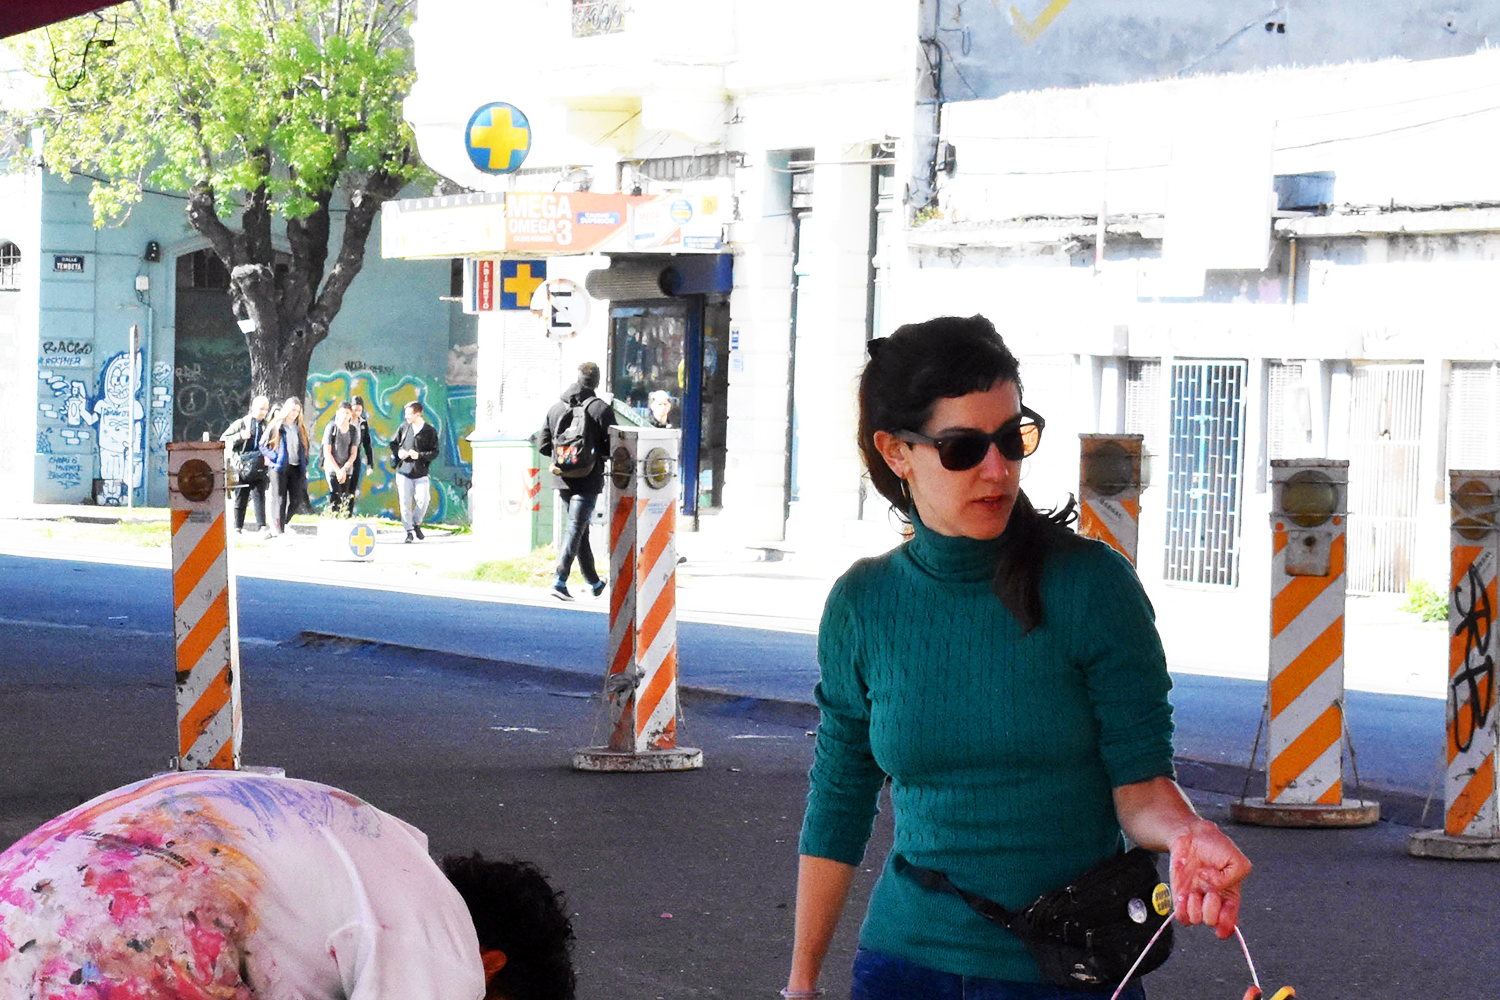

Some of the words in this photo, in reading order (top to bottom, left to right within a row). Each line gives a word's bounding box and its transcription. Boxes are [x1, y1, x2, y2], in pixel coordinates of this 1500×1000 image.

[507, 195, 572, 218] MEGA
[509, 218, 557, 234] OMEGA
[556, 219, 572, 246] 3
